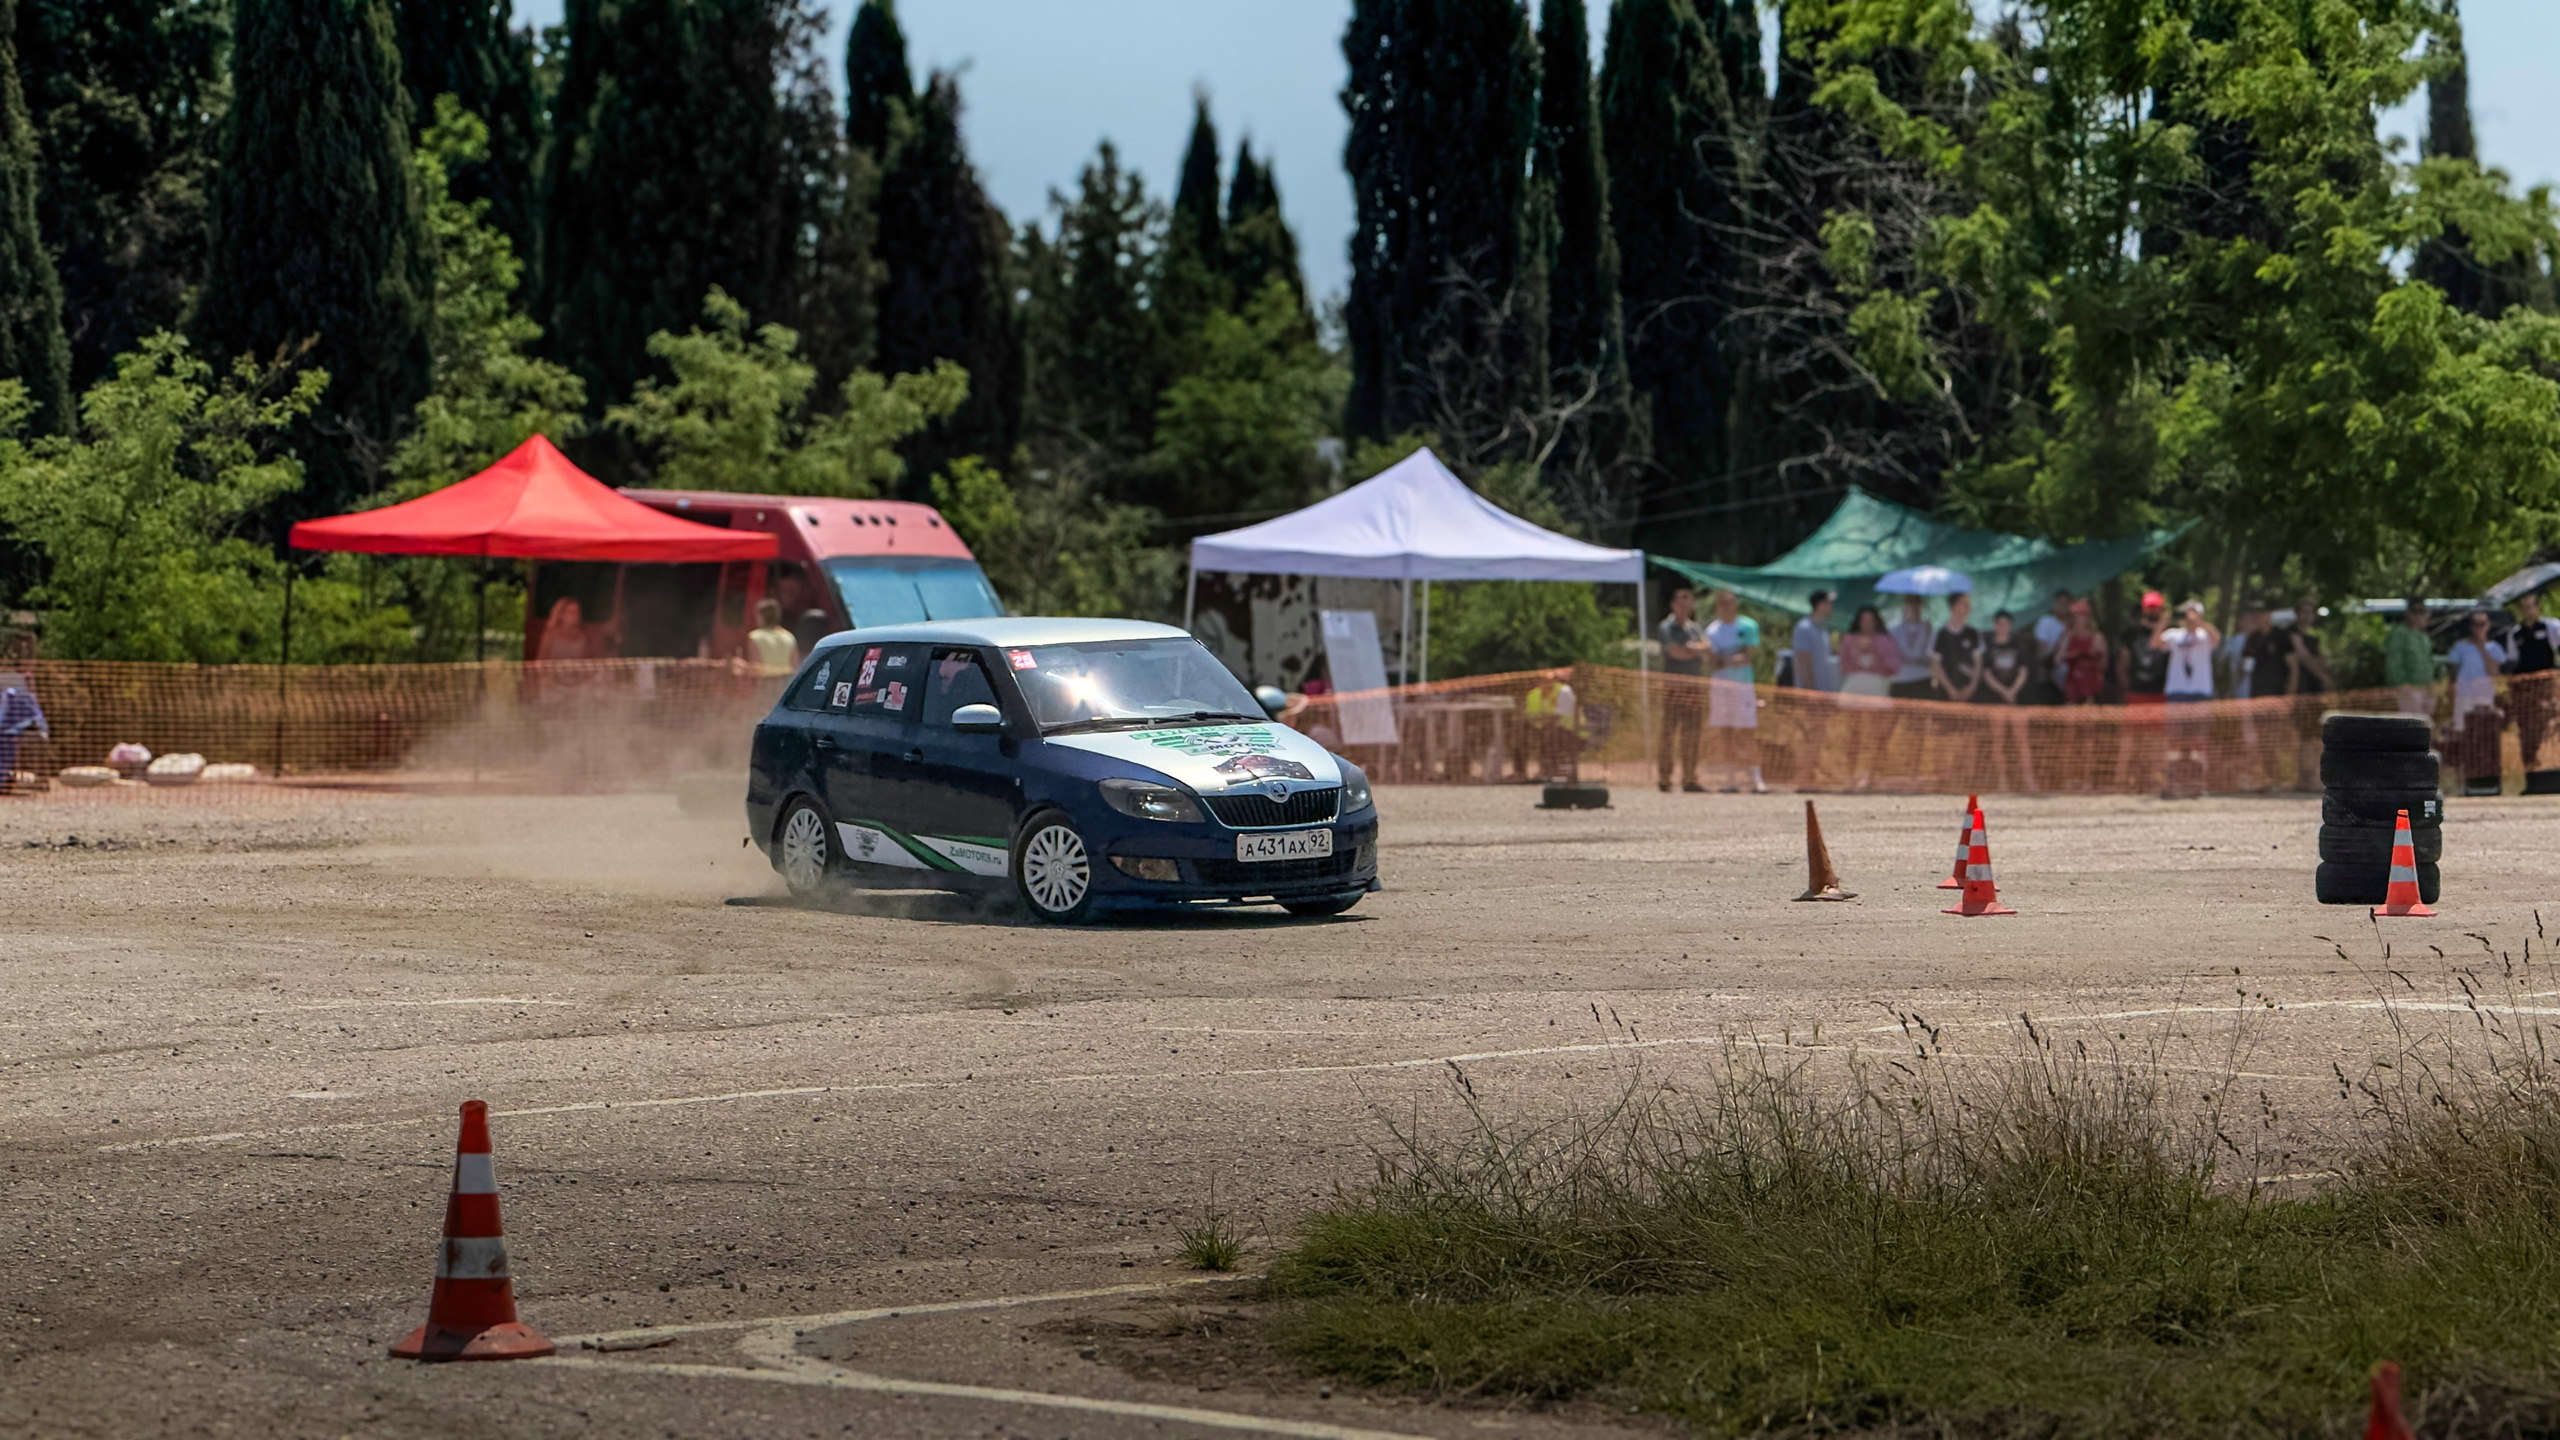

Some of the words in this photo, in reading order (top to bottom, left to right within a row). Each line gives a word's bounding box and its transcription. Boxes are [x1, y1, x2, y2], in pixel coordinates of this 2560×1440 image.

[1013, 654, 1035, 669] 25
[858, 660, 878, 685] 25
[1310, 834, 1325, 847] 92
